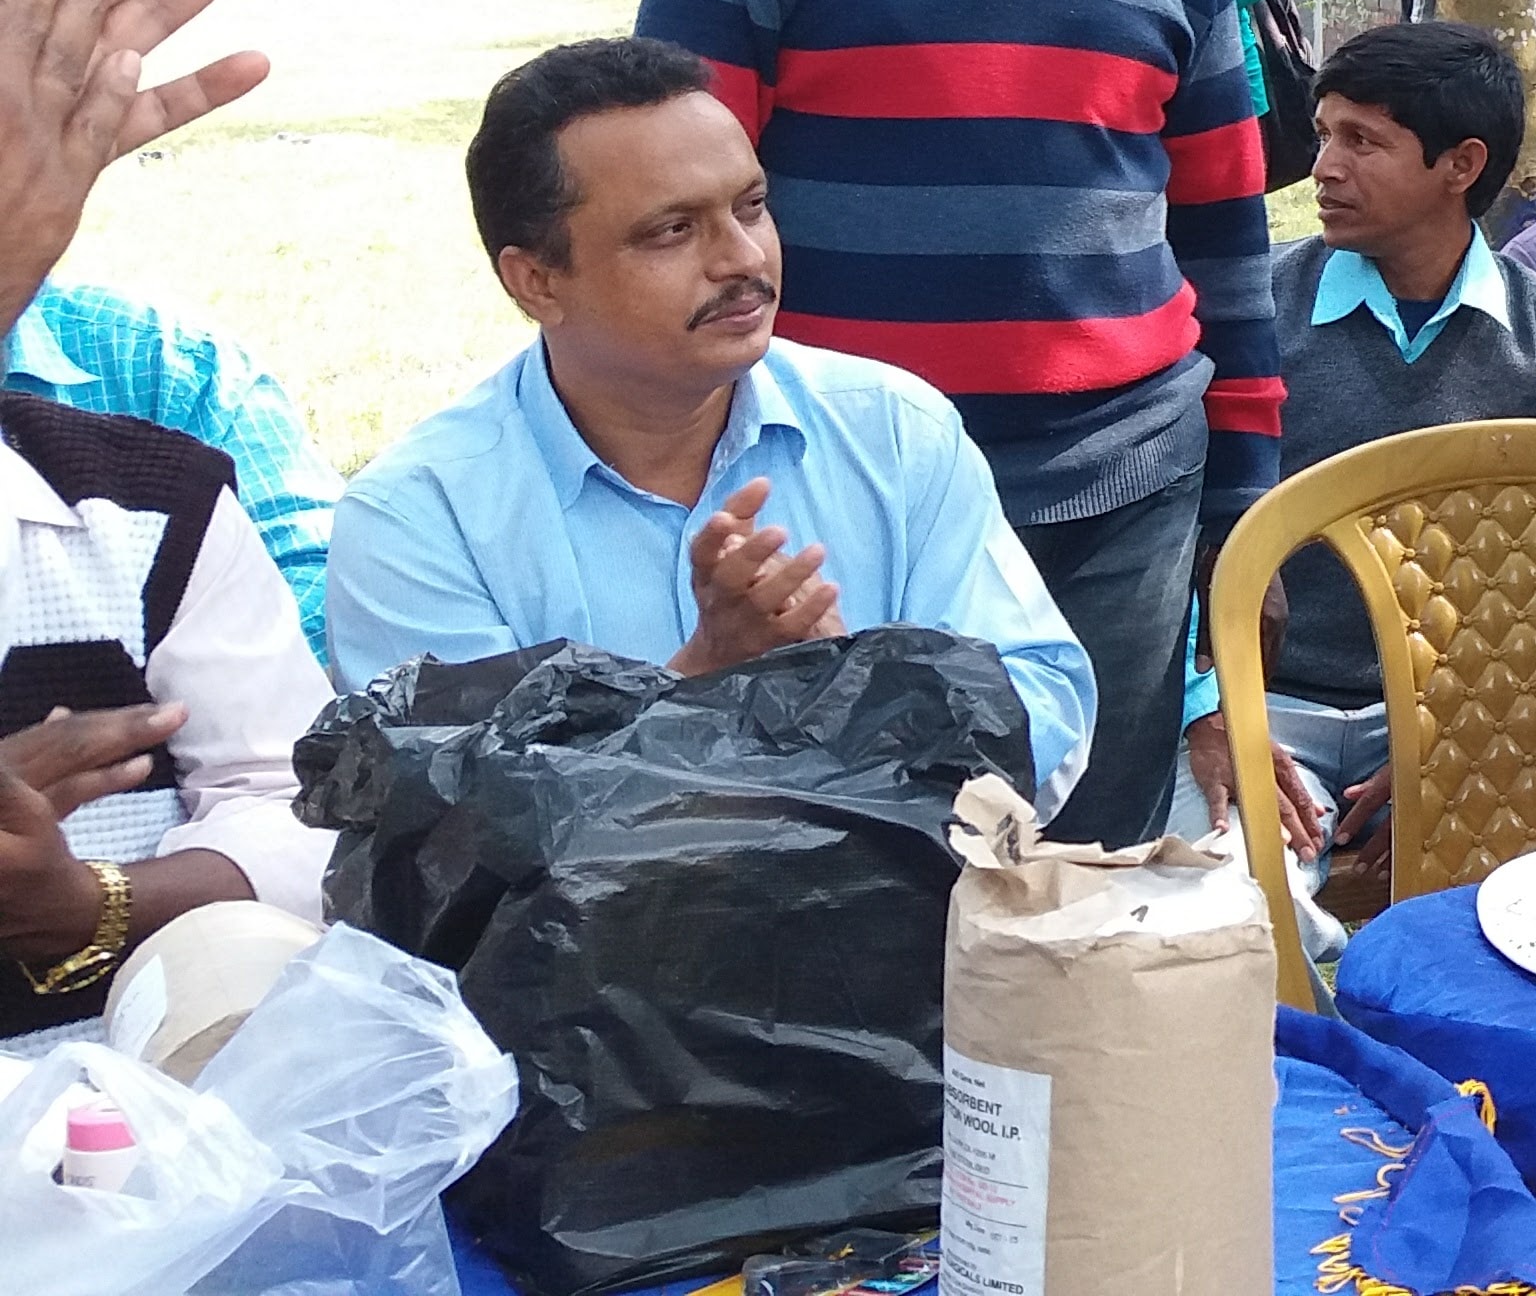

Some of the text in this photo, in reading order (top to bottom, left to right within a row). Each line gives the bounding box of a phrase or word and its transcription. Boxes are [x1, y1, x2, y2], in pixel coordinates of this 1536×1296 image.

[963, 1113, 998, 1136] WOOL
[1001, 1125, 1021, 1141] I.P.
[982, 1277, 1024, 1295] LIMITED
